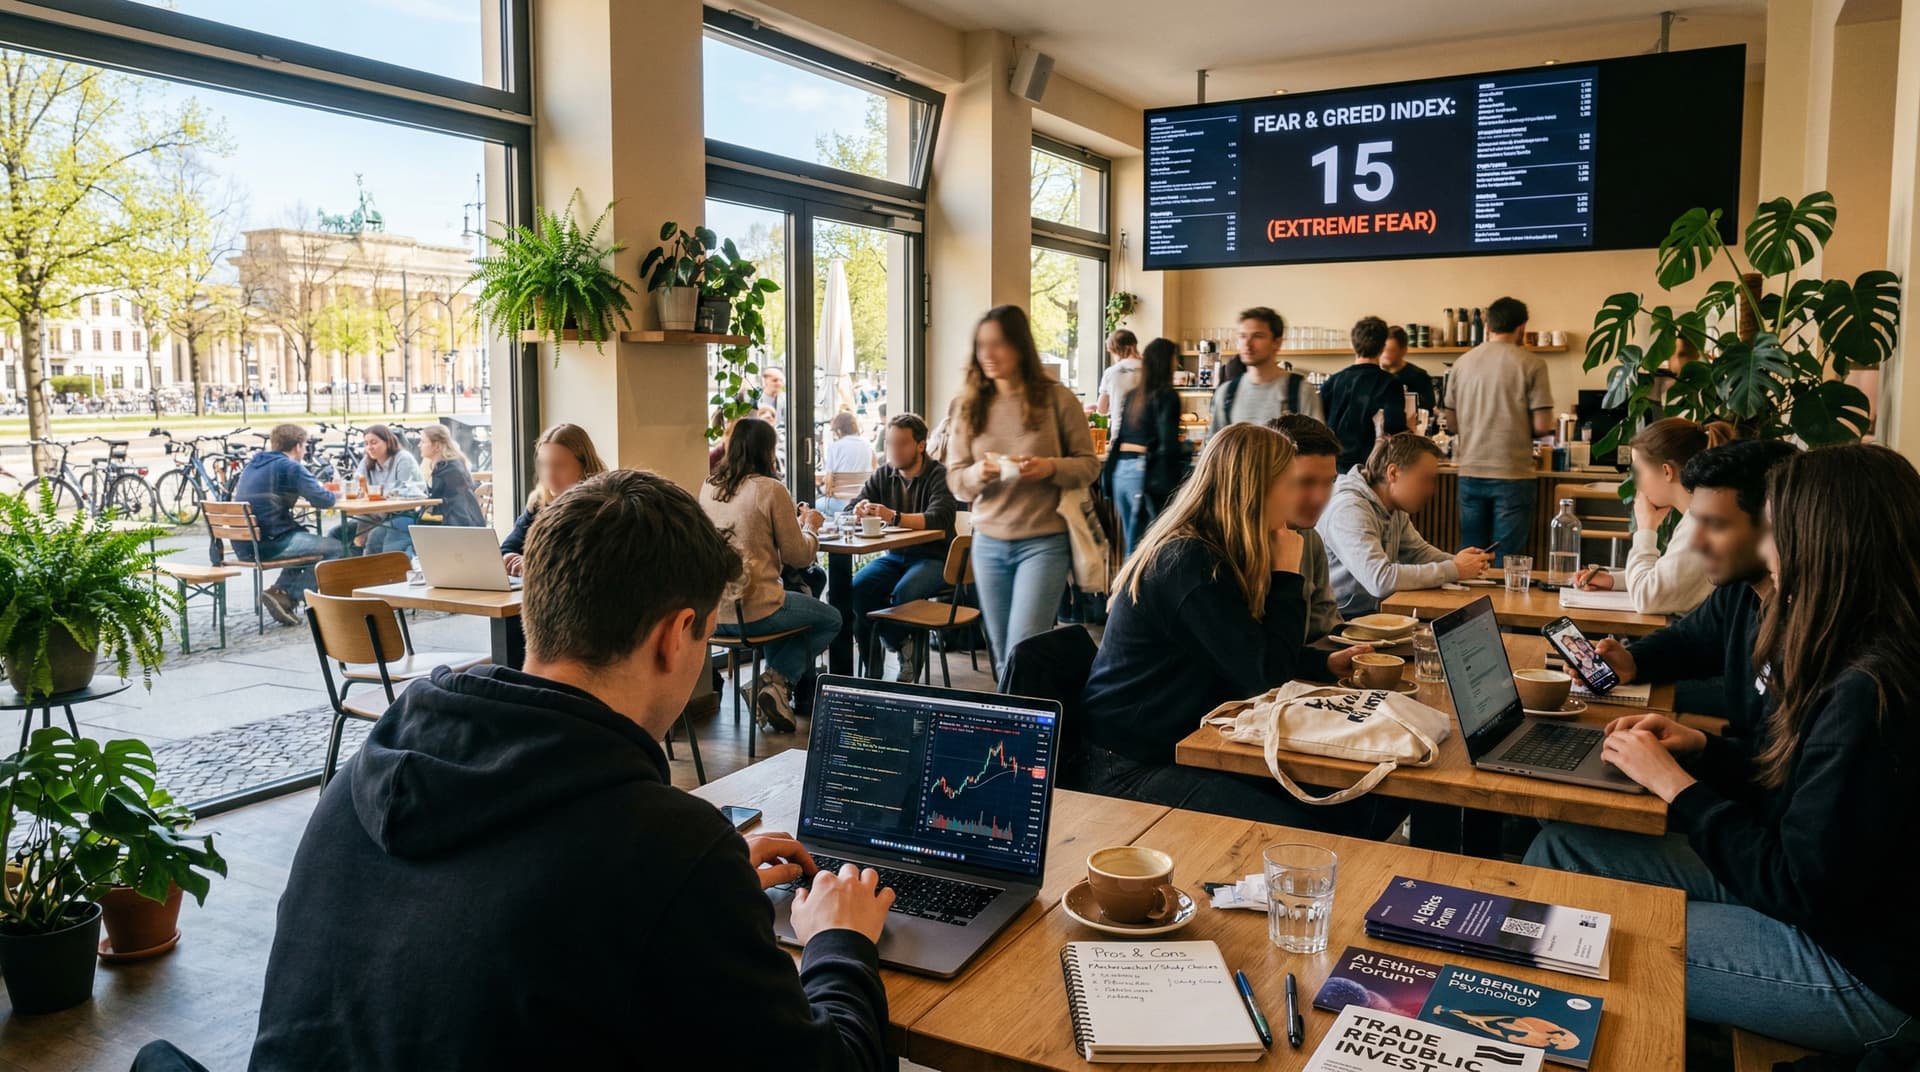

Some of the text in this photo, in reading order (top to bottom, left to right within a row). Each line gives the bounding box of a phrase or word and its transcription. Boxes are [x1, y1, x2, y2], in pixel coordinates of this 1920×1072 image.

[1254, 113, 1301, 133] FEAR
[1305, 111, 1318, 128] &
[1323, 104, 1386, 126] GREED
[1391, 97, 1456, 120] INDEX:
[1311, 141, 1394, 204] 15
[1267, 215, 1370, 243] (EXTREME
[1374, 209, 1437, 235] FEAR)
[1412, 895, 1443, 925] AI Ethics
[1430, 907, 1457, 929] Forum
[1091, 947, 1187, 958] Pros & Cons
[1352, 953, 1438, 979] AI Ethics
[1348, 962, 1414, 984] Forum
[1451, 971, 1540, 998] HU BERLIN
[1448, 979, 1537, 1008] Psychology
[1353, 1015, 1442, 1047] TRADE
[1335, 1041, 1438, 1072] INVEST
[1343, 1027, 1484, 1072] REPUBLIC
